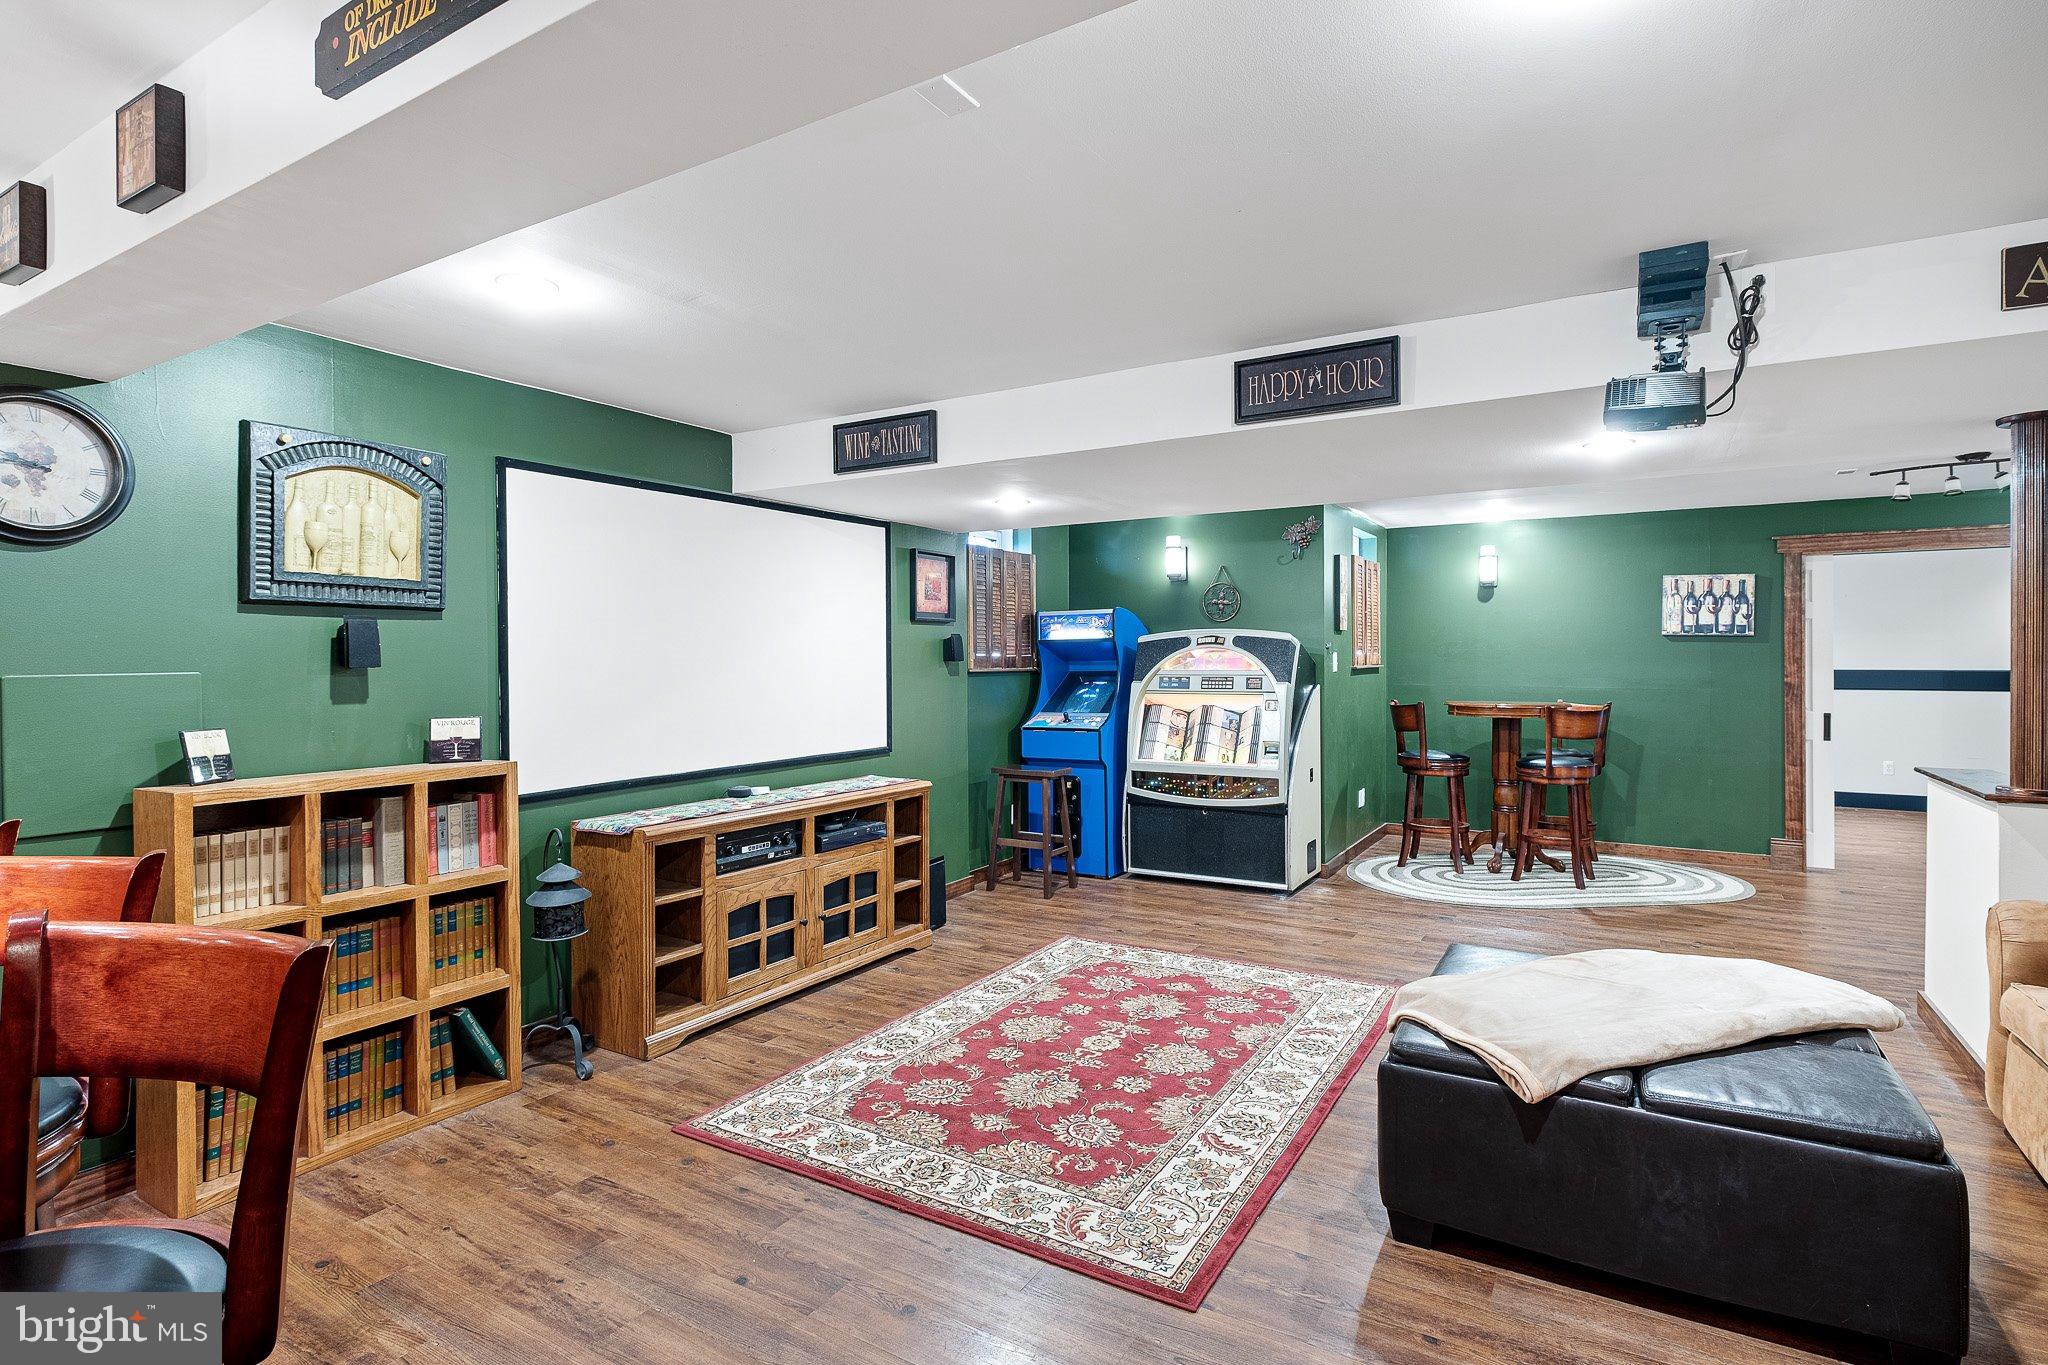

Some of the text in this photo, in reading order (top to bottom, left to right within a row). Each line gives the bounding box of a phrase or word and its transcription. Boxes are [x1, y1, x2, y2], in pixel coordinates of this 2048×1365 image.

[344, 2, 365, 32] OF
[1248, 356, 1385, 407] HAPPY HOUR
[844, 424, 922, 461] WINE TASTING
